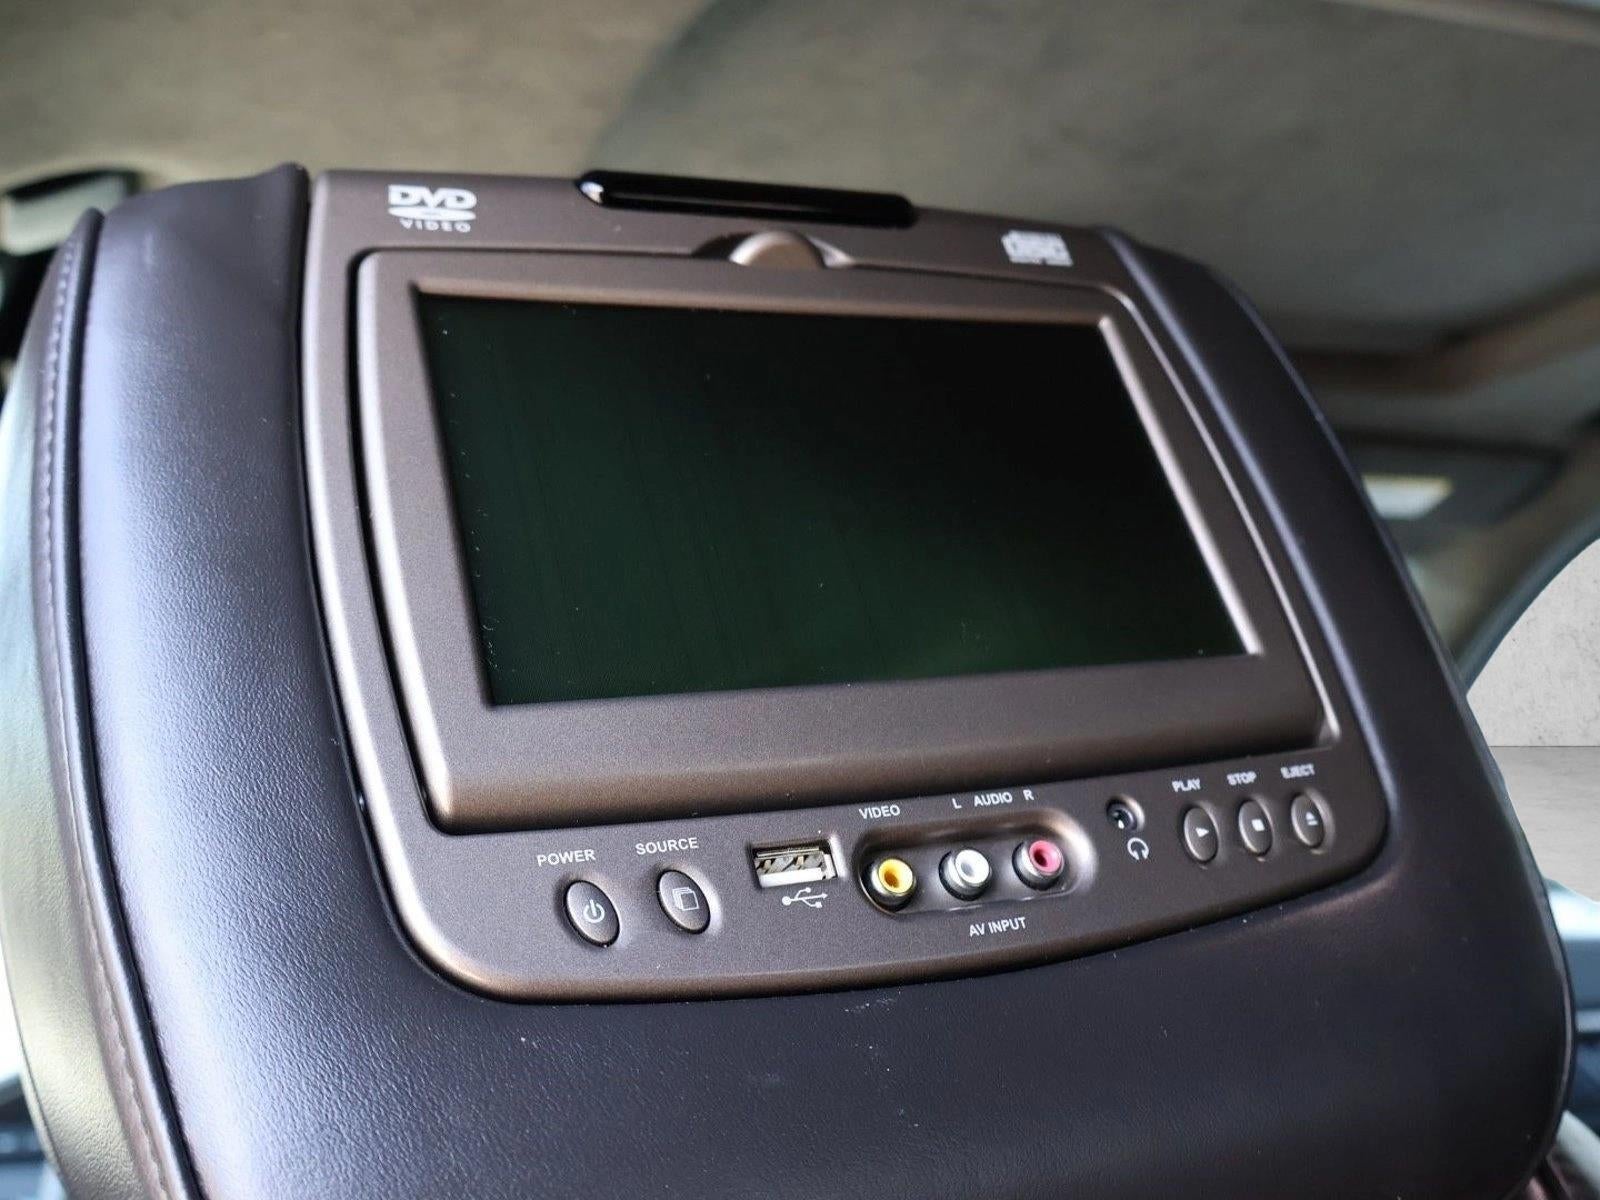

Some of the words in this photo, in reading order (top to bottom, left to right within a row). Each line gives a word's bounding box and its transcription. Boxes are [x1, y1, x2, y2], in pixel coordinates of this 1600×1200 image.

[388, 184, 477, 209] DVD
[399, 218, 471, 233] VIDEO
[1226, 770, 1257, 786] STOP
[1280, 763, 1316, 779] EJECT
[1171, 778, 1201, 793] PLAY
[952, 798, 962, 810] L
[974, 792, 1013, 808] AUDIO
[1023, 788, 1035, 801] R
[858, 804, 901, 820] VIDEO
[635, 836, 700, 856] SOURCE
[536, 848, 597, 867] POWER
[968, 922, 986, 938] AV
[987, 916, 1027, 935] INPUT
